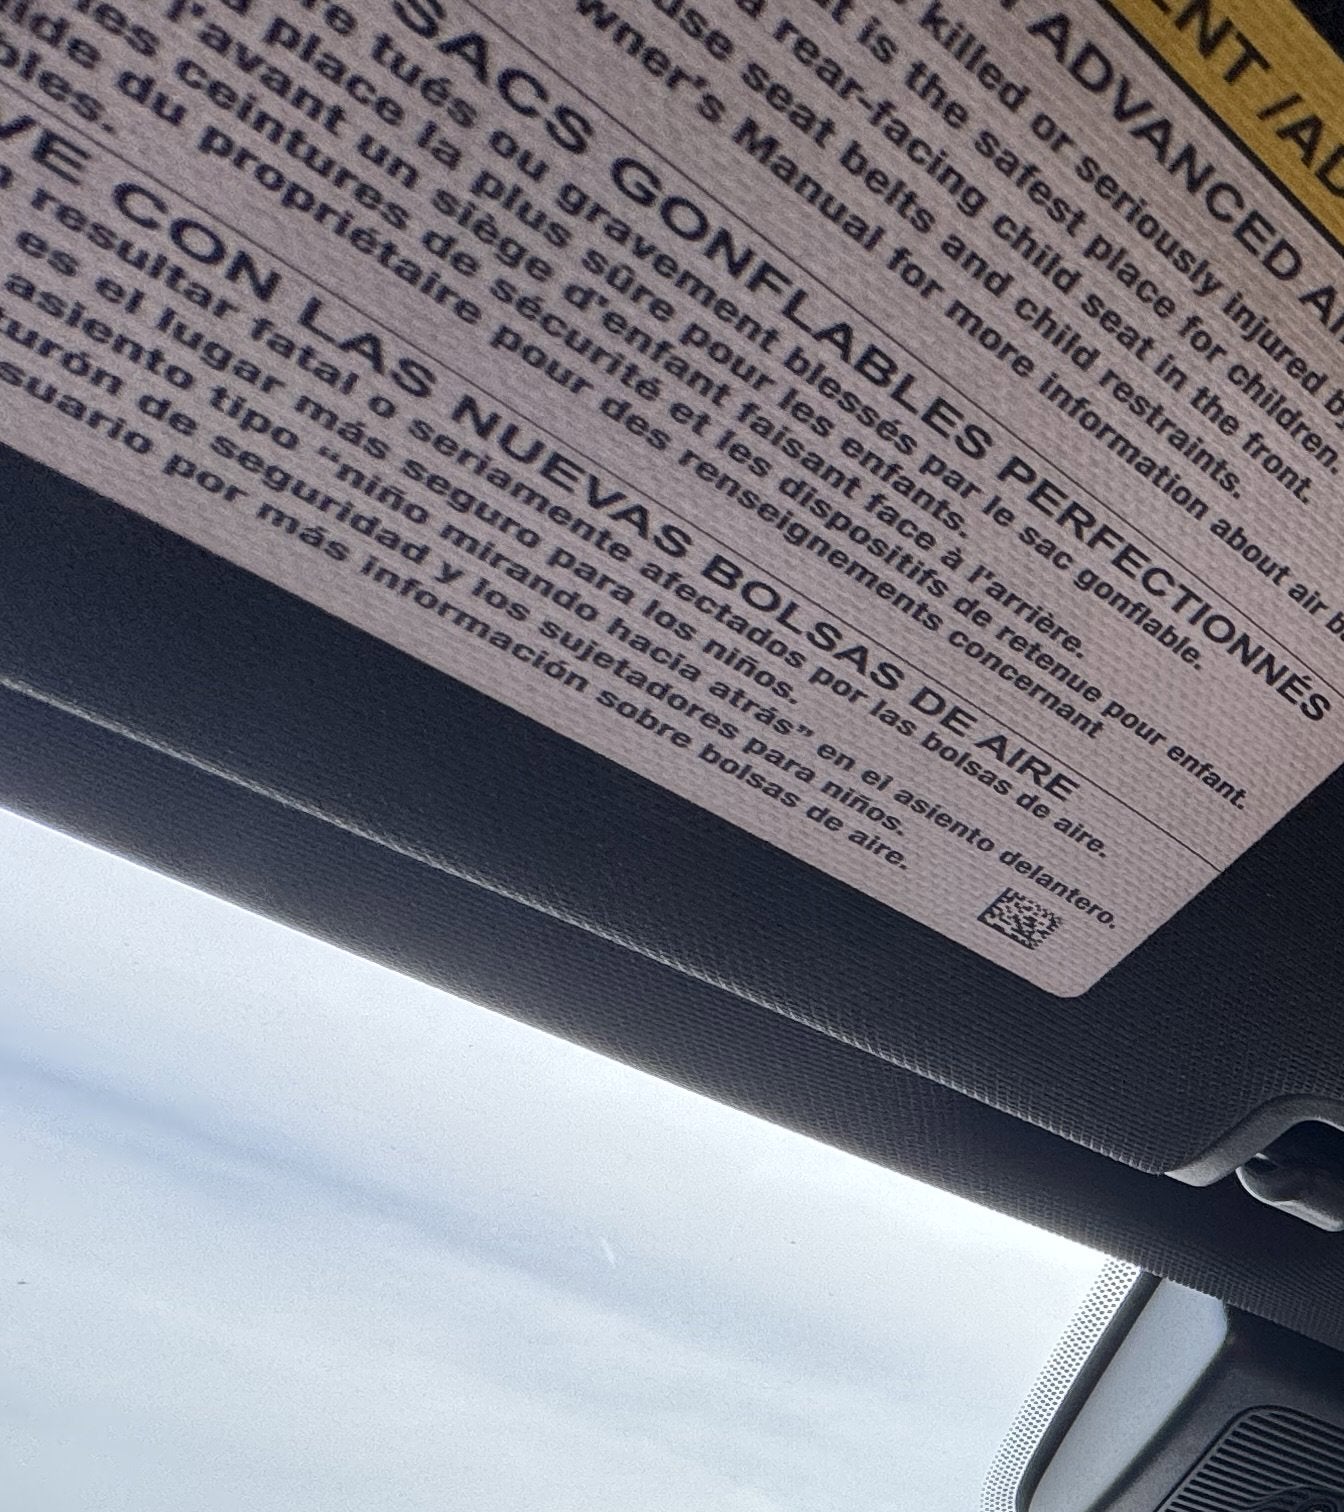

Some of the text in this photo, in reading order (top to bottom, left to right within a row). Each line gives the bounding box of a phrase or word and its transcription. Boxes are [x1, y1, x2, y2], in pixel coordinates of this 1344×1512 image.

[261, 14, 968, 539] place la plus sûre pour les enfants.
[355, 132, 420, 190] un
[430, 187, 555, 284] siège
[561, 282, 732, 409] d'enfant
[734, 400, 862, 500] faisant
[862, 491, 937, 552] face
[938, 545, 965, 572] à
[965, 563, 1084, 660] l'arrière.
[369, 31, 1202, 671] tués ou gravement blessés par le sac gonflable.
[391, 0, 1332, 722] SACS GONFLABLES PERFECTIONNÉS
[730, 115, 887, 253] Manual
[885, 245, 945, 300] for
[943, 297, 1035, 379] more
[1037, 370, 1210, 521] information
[1208, 517, 1291, 587] about
[1286, 582, 1330, 616] air
[739, 60, 836, 150] seat
[837, 138, 936, 234] belts
[939, 232, 1016, 299] and
[1012, 295, 1101, 373] child
[1096, 367, 1241, 500] restraints.
[771, 17, 1312, 505] rear-facing child seat in the front.
[855, 15, 1339, 476] is the safest place for children.
[917, 0, 1033, 114] killed
[1028, 111, 1076, 154] or
[1073, 154, 1226, 298] seriously
[1220, 289, 1330, 397] injured
[1024, 11, 1304, 282] ADVANCED
[4, 272, 196, 391] asiento
[208, 385, 300, 451] tipo
[437, 522, 600, 622] mirando
[605, 615, 702, 683] hacia
[815, 742, 856, 772] en
[859, 768, 894, 792] el
[892, 788, 995, 852] asiento
[997, 849, 1116, 930] delantero.
[14, 230, 80, 277] es
[93, 276, 146, 315] el
[154, 306, 286, 394] lugar
[293, 394, 391, 461] más
[398, 458, 542, 549] seguro
[545, 545, 636, 606] para
[640, 598, 698, 642] los
[700, 637, 798, 705] niños.
[29, 186, 240, 319] resultar
[249, 316, 360, 396] fatal
[366, 393, 397, 420] o
[406, 418, 633, 563] seriamente
[637, 561, 807, 669] afectados
[806, 665, 869, 704] por
[867, 697, 918, 737] las
[918, 729, 1014, 796] bolsas
[1014, 791, 1051, 819] de
[1051, 816, 1107, 859] aire.
[110, 181, 1081, 803] CON LAS NUEVAS BOLSAS DE AIRE
[114, 69, 188, 128] du
[196, 124, 482, 325] propriétaire
[488, 323, 594, 395] pour
[598, 396, 672, 451] des
[676, 448, 944, 632] renseignements
[946, 629, 1104, 740] concernant
[135, 393, 904, 837] de seguridad y los sujetadores para niños.
[173, 57, 1247, 811] ceintures de sécurité et les dispositifs de retenue pour enfant.
[161, 452, 249, 503] por
[255, 501, 351, 562] más
[359, 554, 590, 693] información
[594, 688, 692, 749] sobre
[696, 741, 802, 808] bolsas
[804, 804, 844, 832] de
[846, 828, 908, 871] aire.
